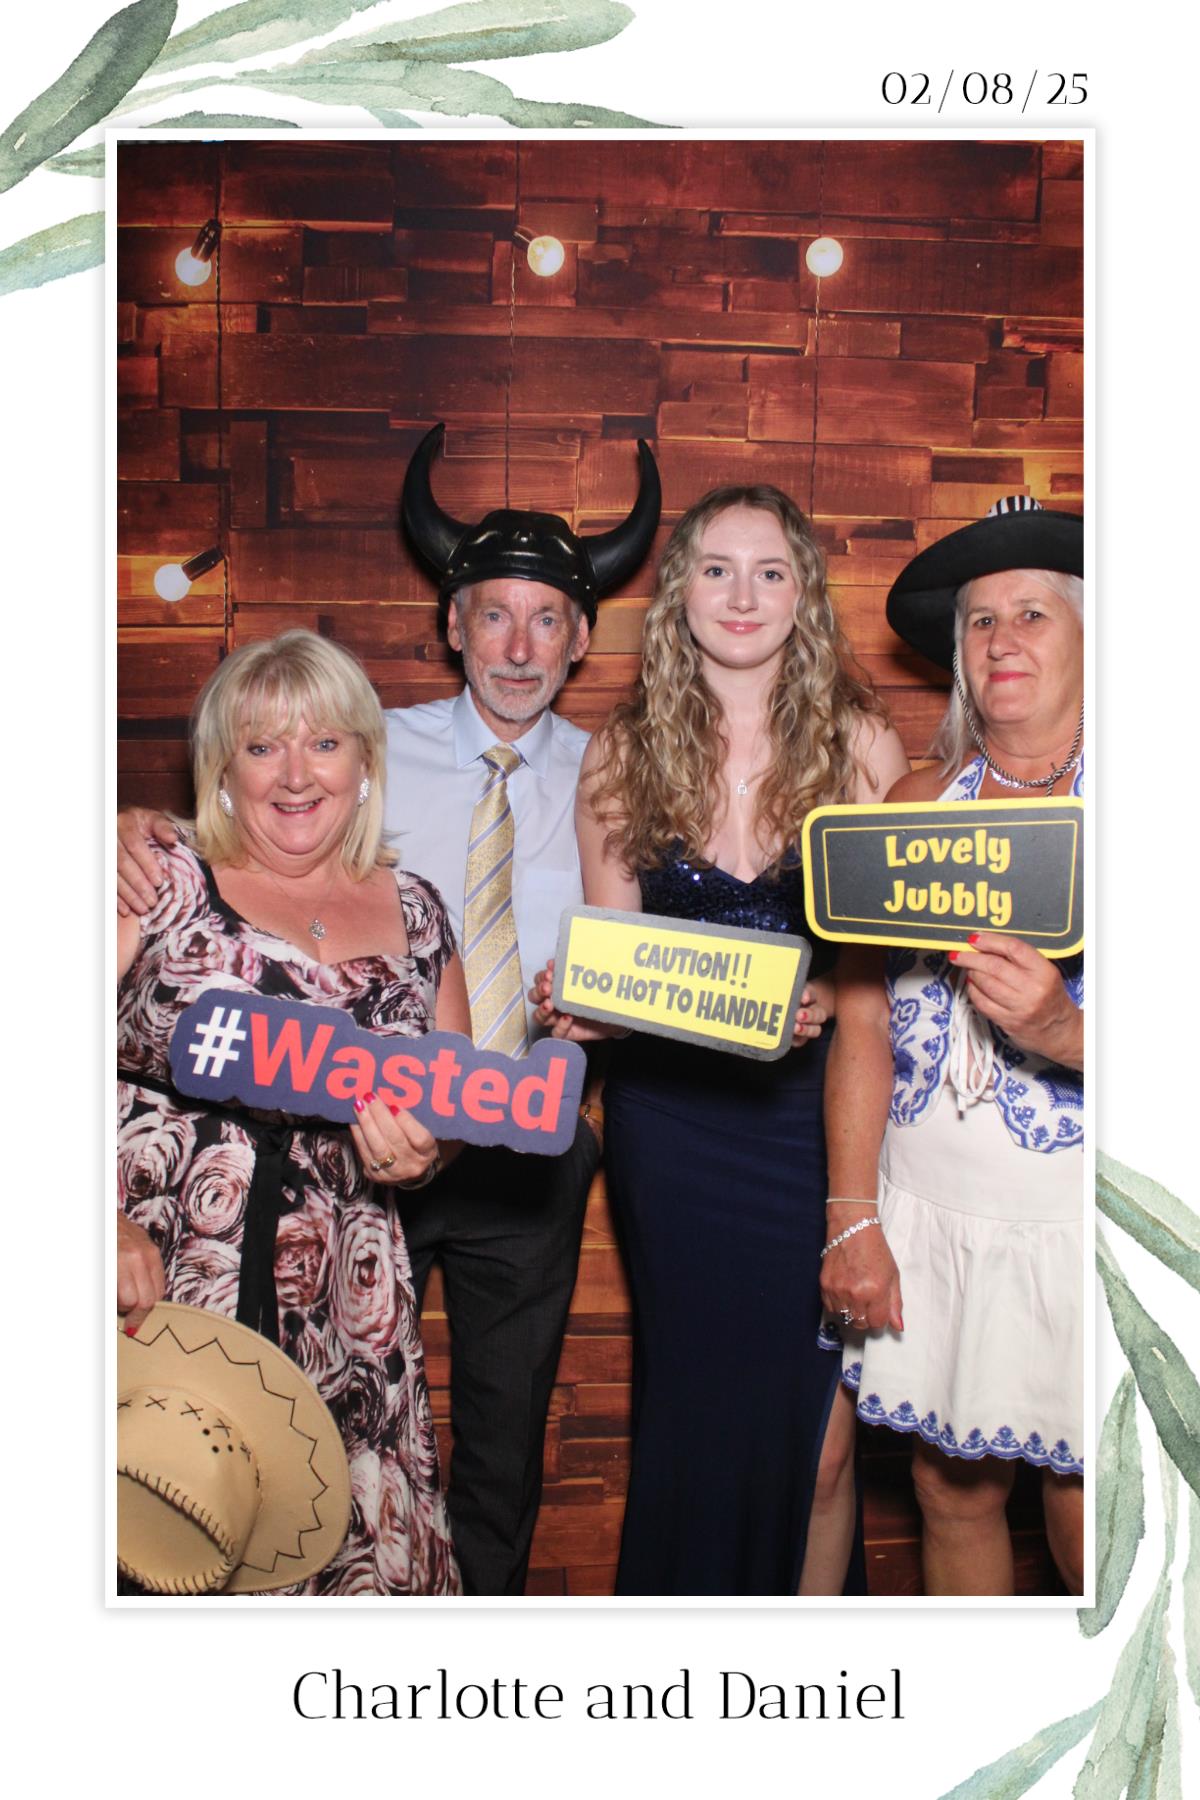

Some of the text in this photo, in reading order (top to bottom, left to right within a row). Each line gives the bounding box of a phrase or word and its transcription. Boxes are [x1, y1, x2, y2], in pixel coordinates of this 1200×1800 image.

[885, 828, 1011, 874] Lovely
[883, 879, 1013, 927] Jubbly
[633, 942, 753, 989] CAUTION!!
[569, 964, 784, 1037] TOO HOT TO HANDLE
[187, 1006, 568, 1133] #Wasted
